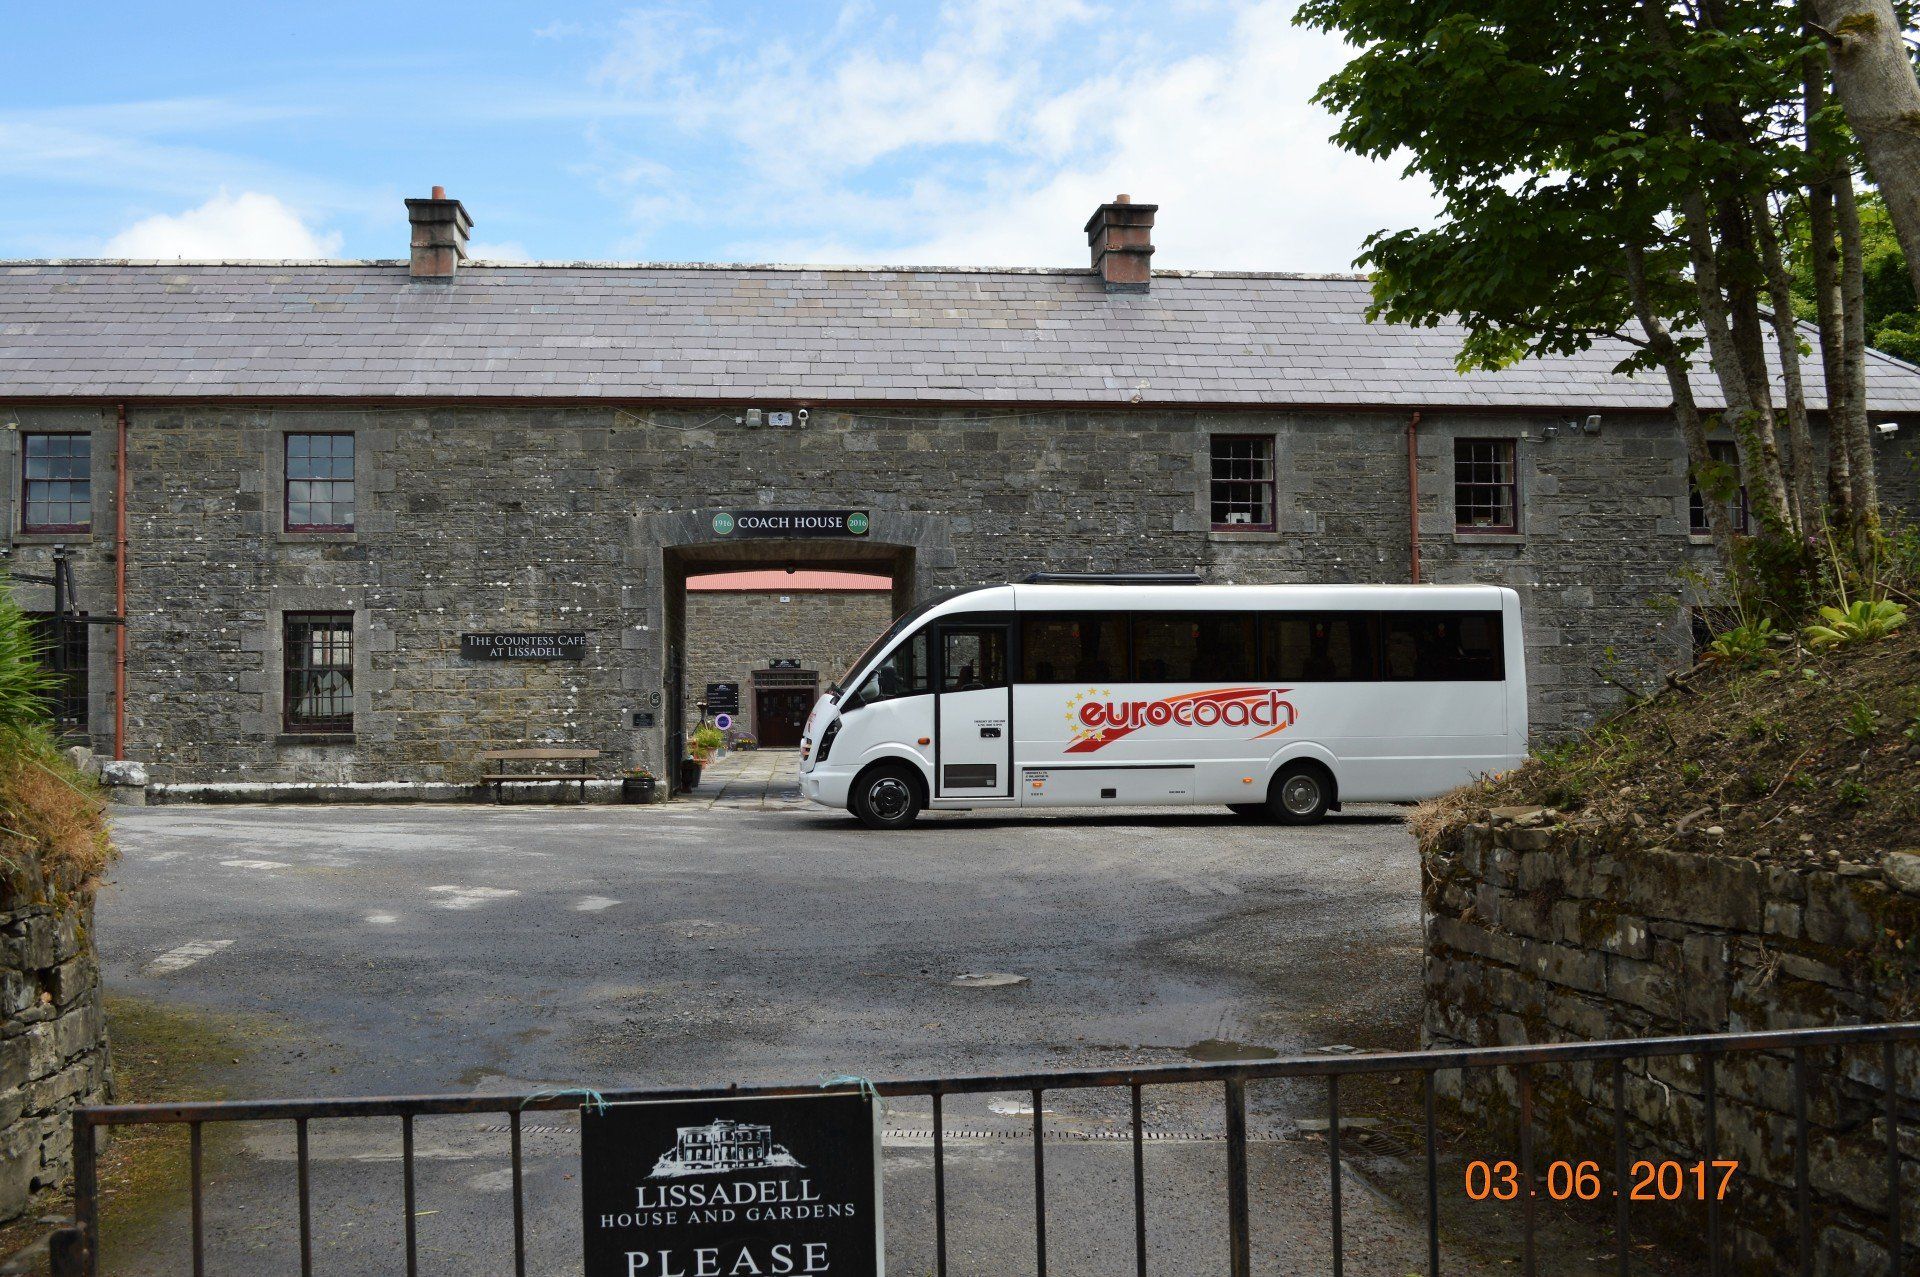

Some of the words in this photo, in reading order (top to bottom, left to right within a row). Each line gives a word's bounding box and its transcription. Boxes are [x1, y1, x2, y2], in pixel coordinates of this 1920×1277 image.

[714, 520, 732, 528] 1916
[738, 517, 789, 529] COACH
[794, 517, 843, 528] HOUSE
[849, 519, 867, 527] 2016
[467, 635, 491, 646] THE
[494, 635, 554, 646] COUNTESS
[557, 635, 586, 646] CAFE
[489, 648, 505, 657] AT
[508, 647, 564, 657] LISSADELL
[1079, 690, 1296, 727] eurocoach
[635, 1179, 821, 1209] LISSADELL
[600, 1211, 678, 1228] HOUSE
[687, 1210, 736, 1225] AND
[746, 1203, 856, 1221] GARDENS
[624, 1242, 831, 1277] PLEASE
